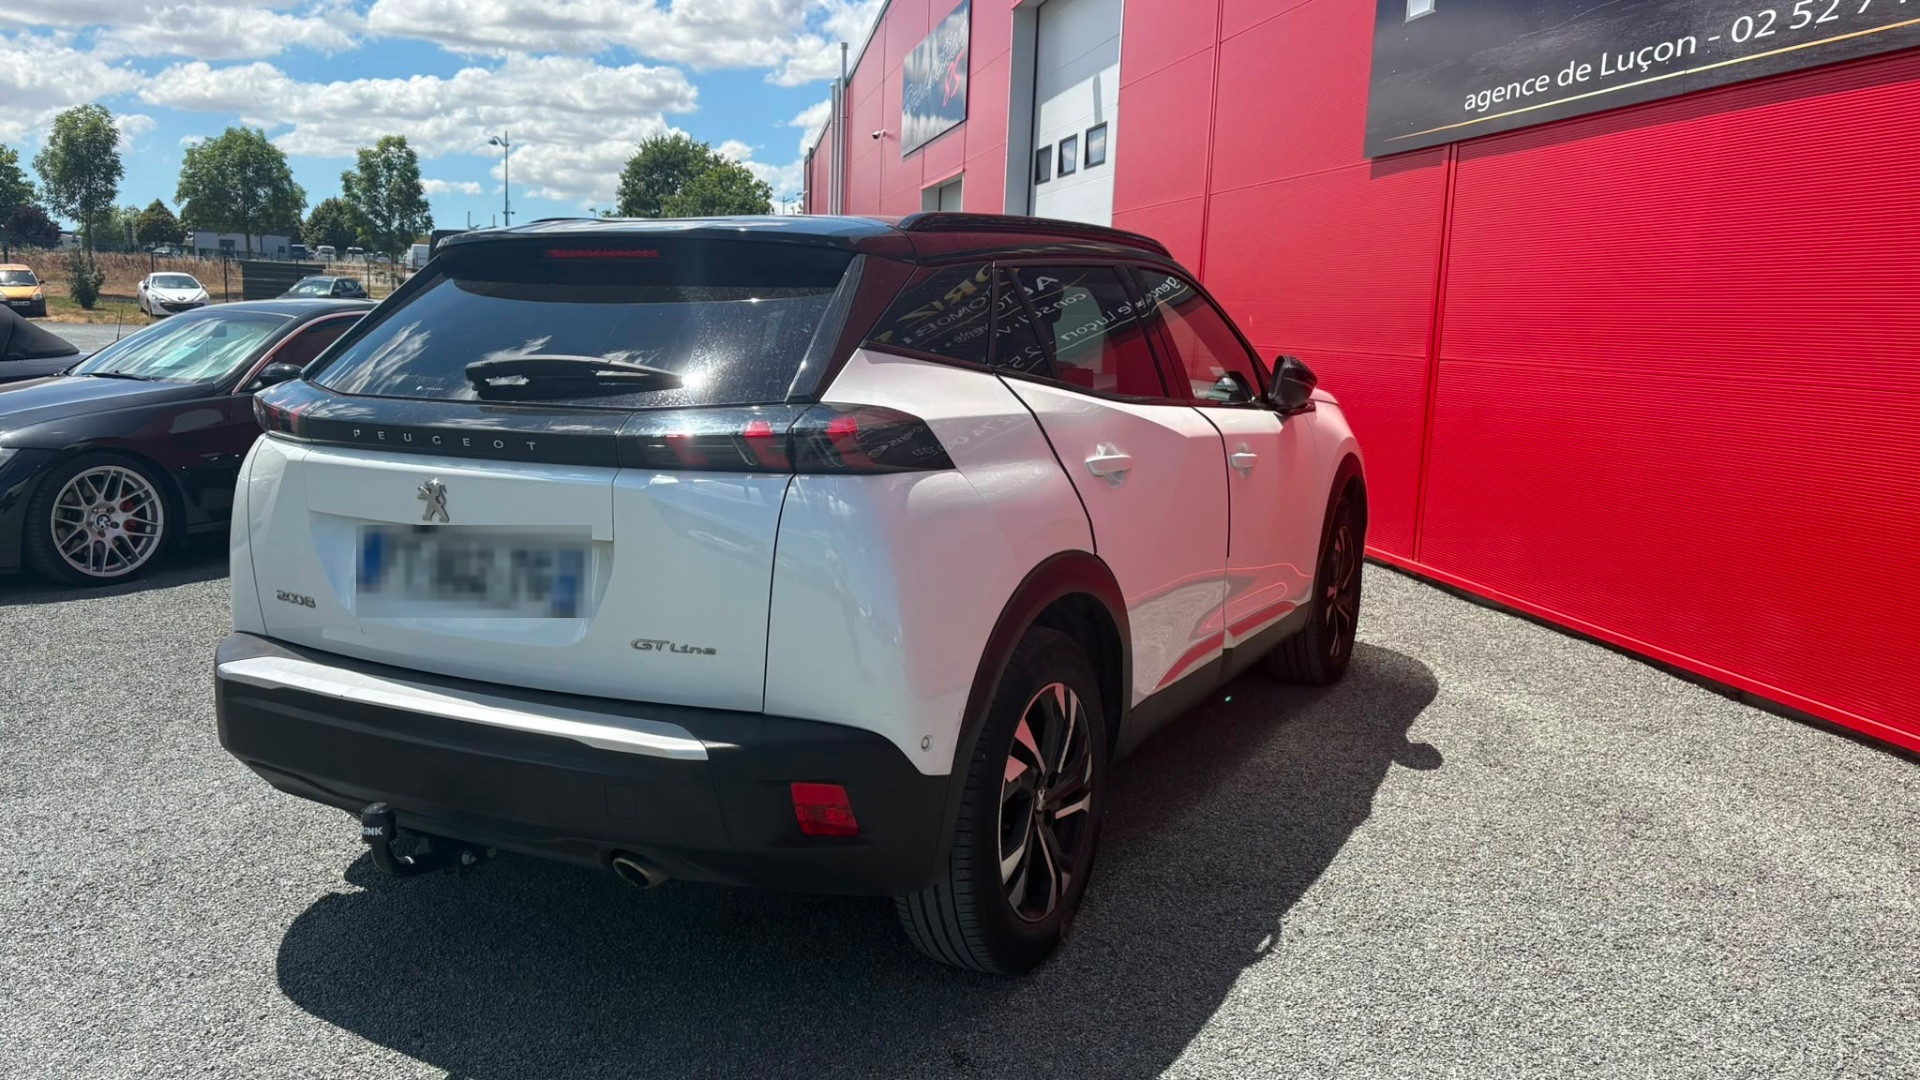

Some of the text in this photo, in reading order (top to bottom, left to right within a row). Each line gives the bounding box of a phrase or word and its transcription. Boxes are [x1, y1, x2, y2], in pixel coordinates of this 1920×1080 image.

[1464, 74, 1550, 112] agence
[1557, 60, 1592, 87] de
[1600, 35, 1697, 76] Luçon
[1731, 9, 1777, 43] 02
[1789, 0, 1840, 30] 52
[353, 429, 536, 451] PEUGEOT
[276, 589, 316, 609] 2008
[630, 638, 670, 651] GT
